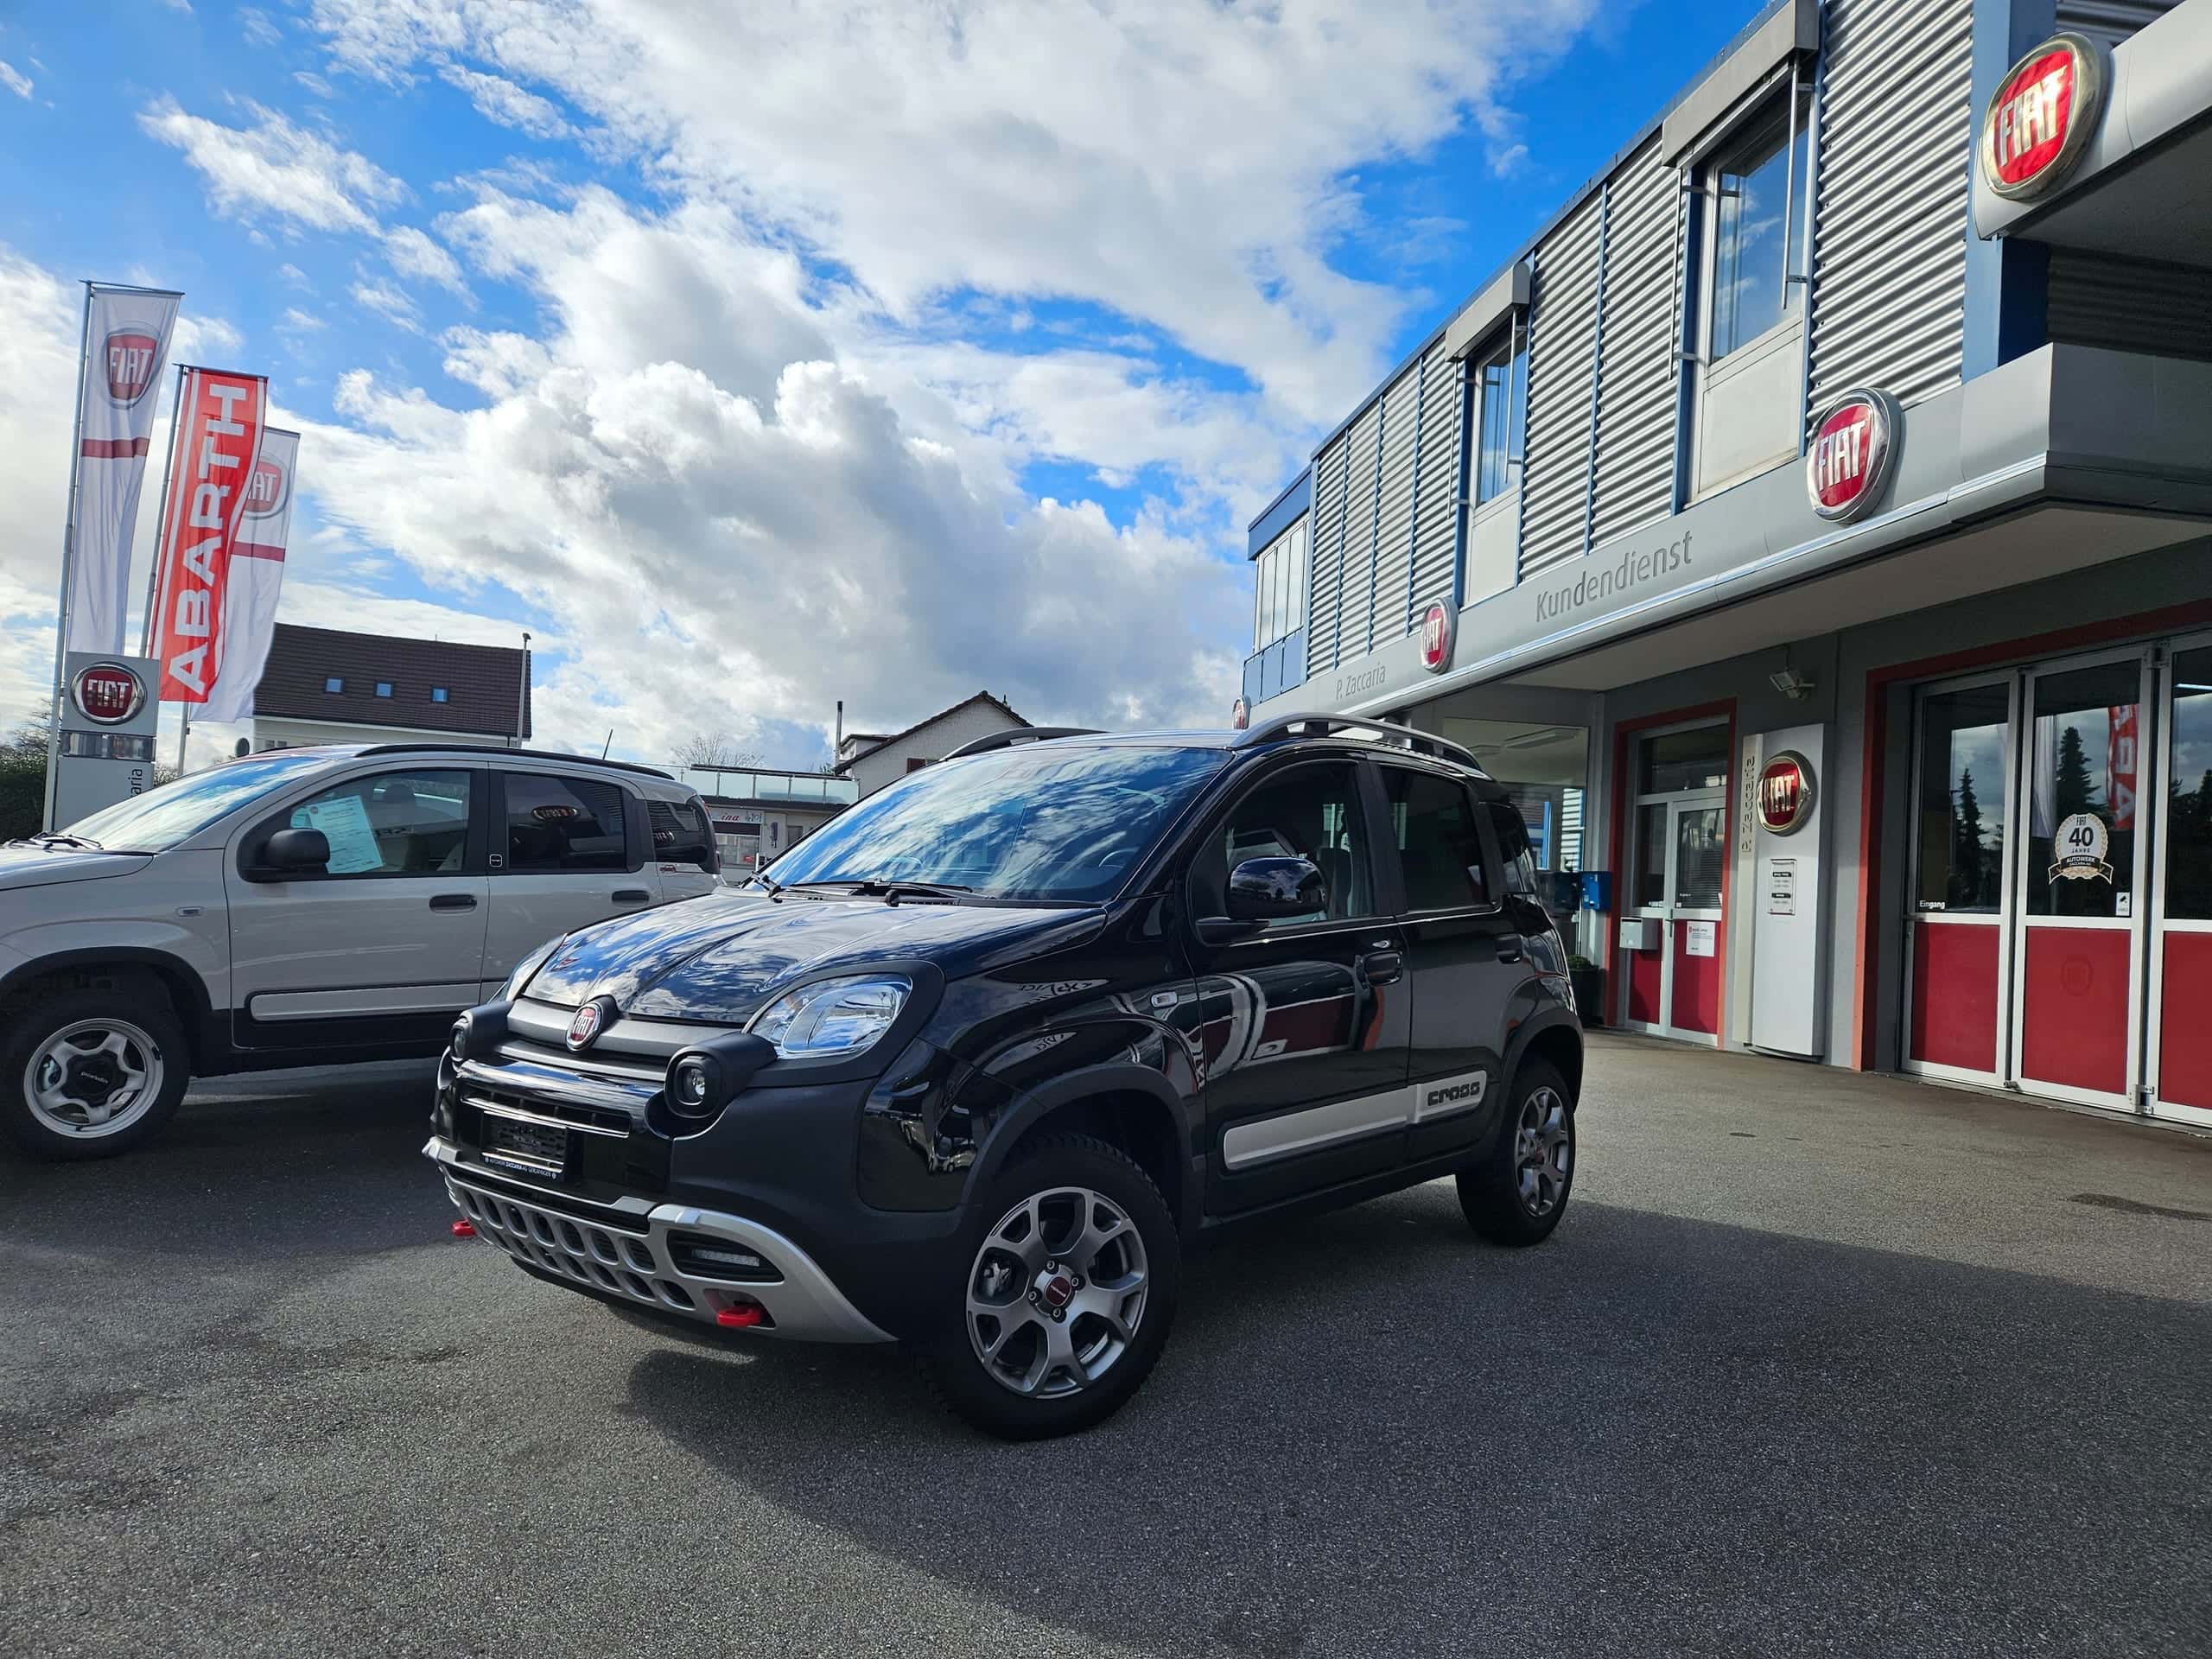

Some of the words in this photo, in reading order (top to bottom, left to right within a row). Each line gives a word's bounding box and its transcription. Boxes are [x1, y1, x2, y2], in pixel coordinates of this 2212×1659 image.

[1999, 65, 2068, 167] FIAT
[110, 346, 153, 384] FIAT
[1818, 420, 1866, 492] FIAT
[248, 471, 277, 502] AT
[168, 383, 246, 696] ABARTH
[1536, 530, 1693, 622] Kundendienst
[87, 678, 130, 709] FIAT
[1336, 679, 1344, 701] P.
[1345, 662, 1386, 696] Zaccaria
[1742, 755, 1756, 834] Zaccaria
[1764, 774, 1795, 814] FIAT
[2069, 826, 2094, 847] 40
[1919, 899, 1945, 910] Eingang
[572, 1015, 594, 1035] FIAT
[1427, 1081, 1481, 1107] cross
